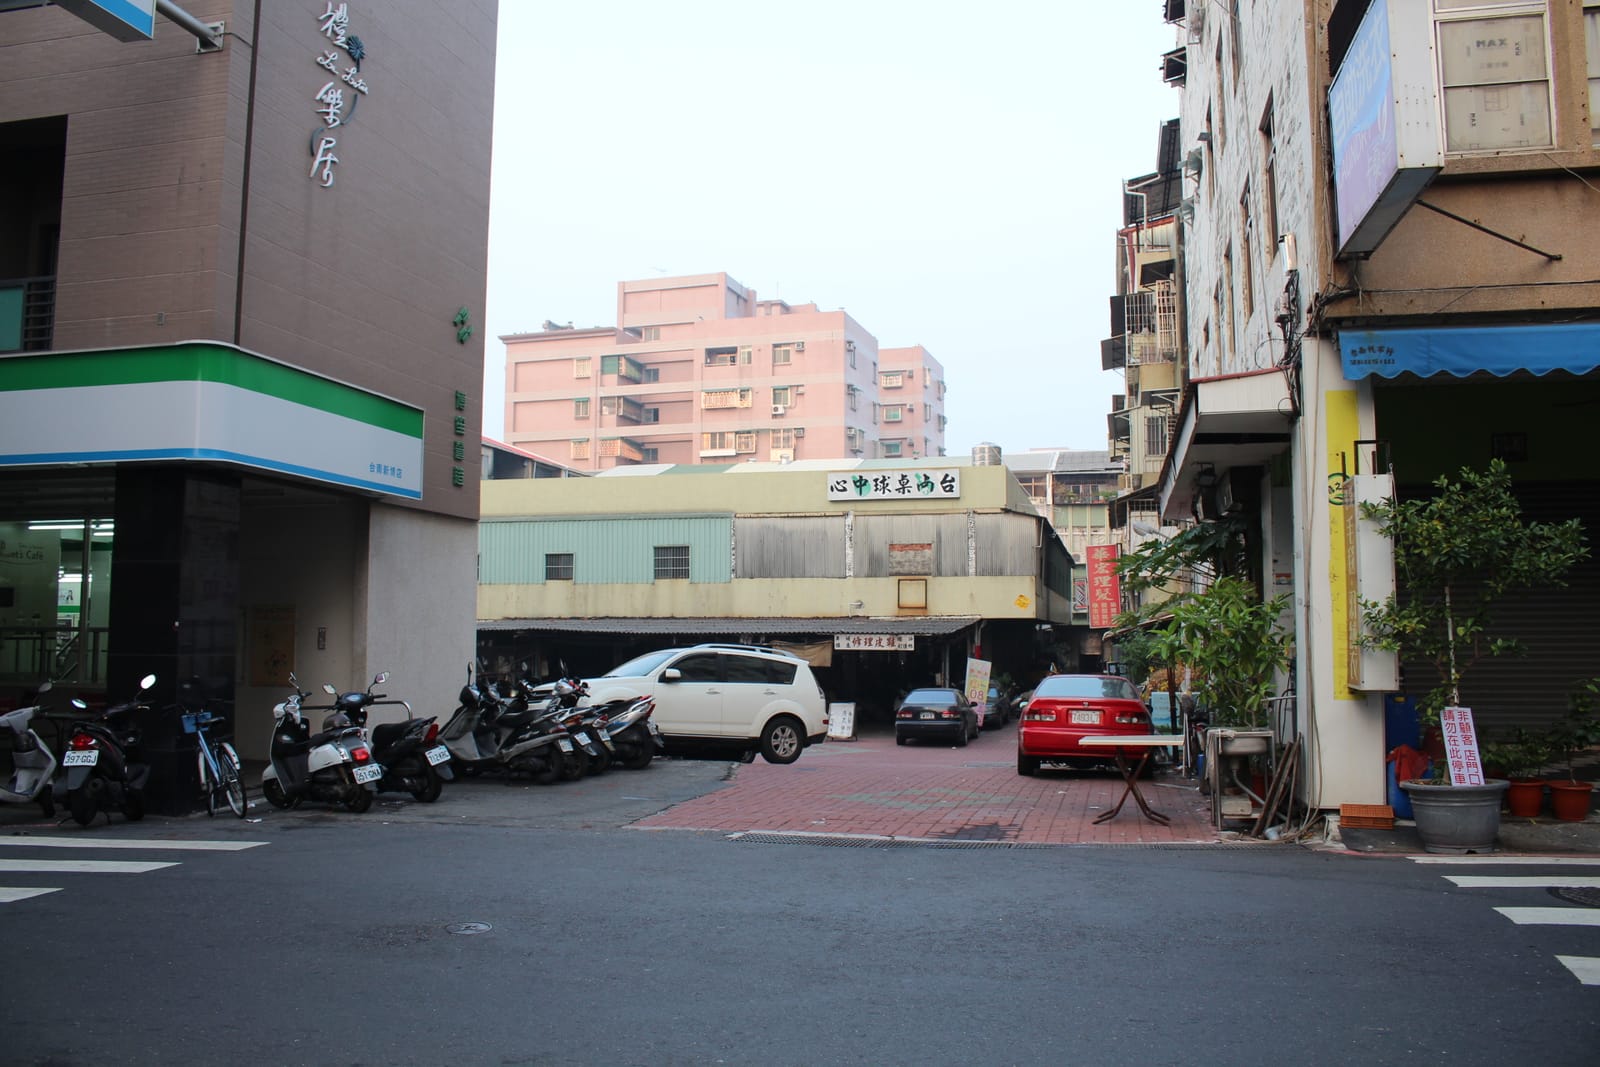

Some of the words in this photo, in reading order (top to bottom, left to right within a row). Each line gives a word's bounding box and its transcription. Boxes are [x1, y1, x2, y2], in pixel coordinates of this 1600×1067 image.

[1443, 709, 1467, 784] 請勿在此停車
